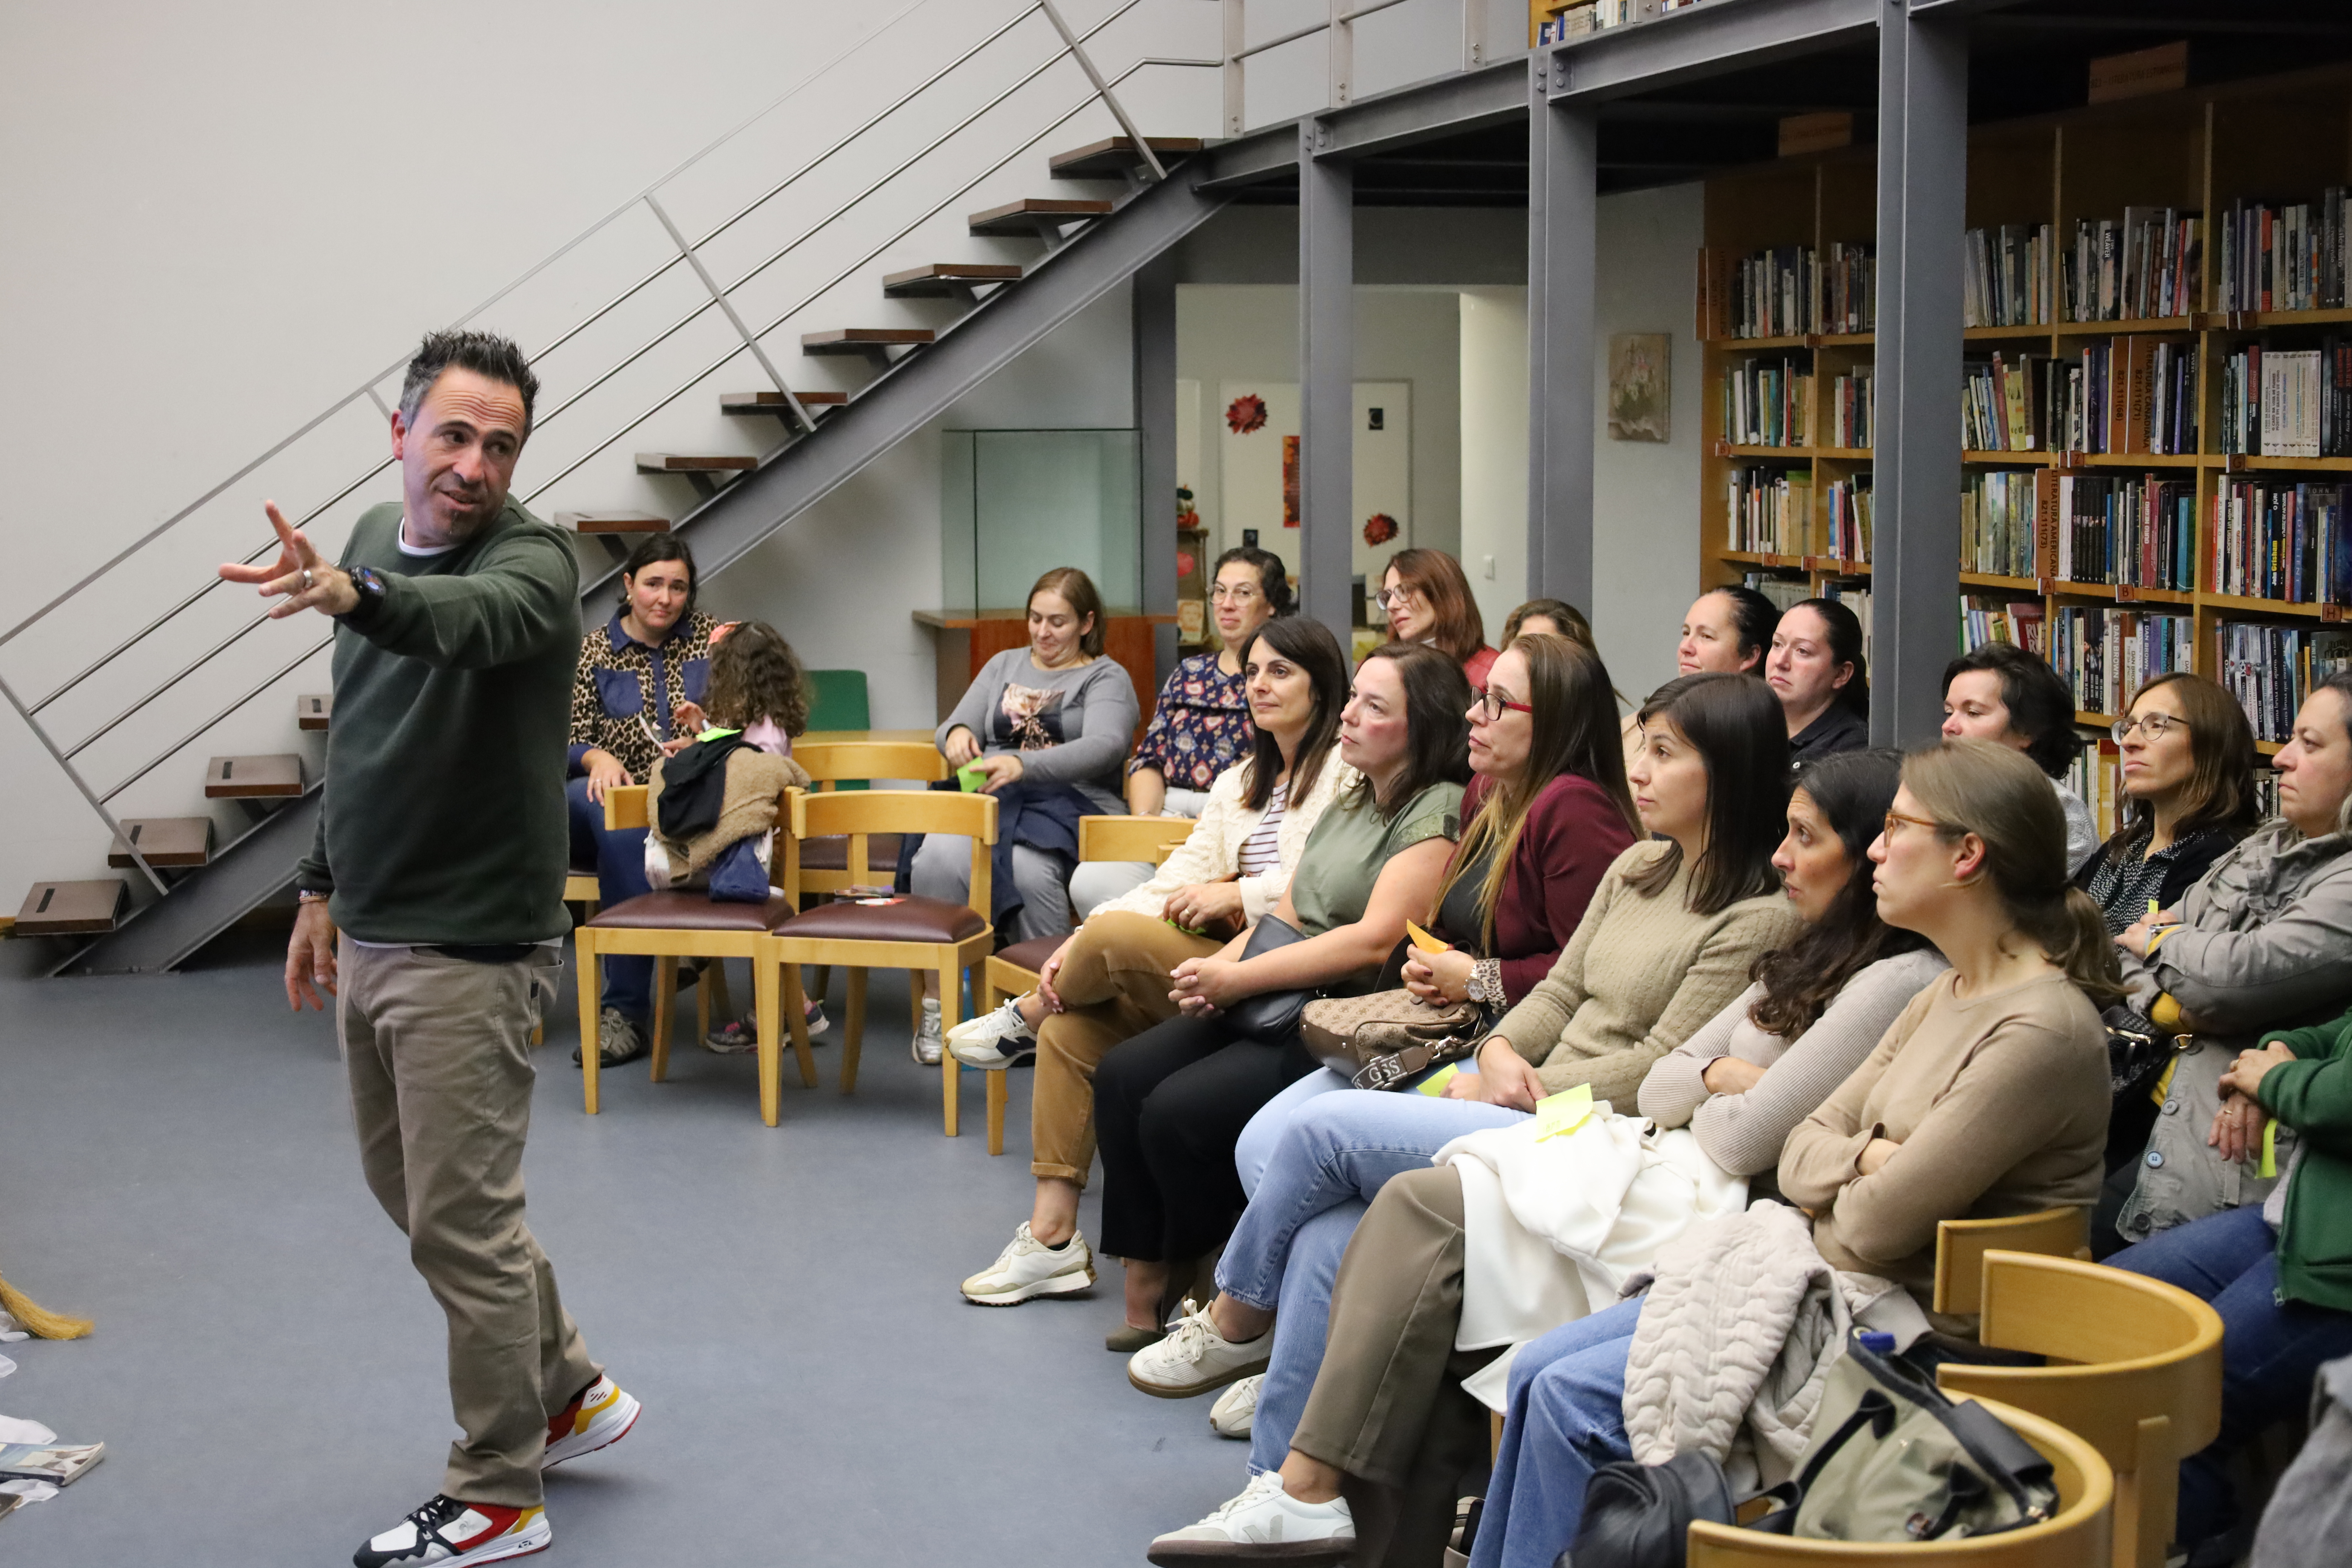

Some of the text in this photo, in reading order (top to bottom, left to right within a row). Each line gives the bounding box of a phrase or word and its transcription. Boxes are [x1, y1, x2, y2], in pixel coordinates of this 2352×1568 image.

[2109, 69, 2144, 85] LITERATURA
[2115, 370, 2125, 421] 821.111(68)
[2133, 369, 2142, 421] 821.111(71)
[2143, 396, 2152, 449] CANADIANA
[2075, 454, 2080, 464] Z
[2233, 456, 2241, 468] G
[2040, 500, 2048, 549] 821.111(73)
[2044, 580, 2051, 591] A
[2122, 586, 2129, 597] B
[2326, 607, 2335, 619] H
[2274, 680, 2278, 690] em
